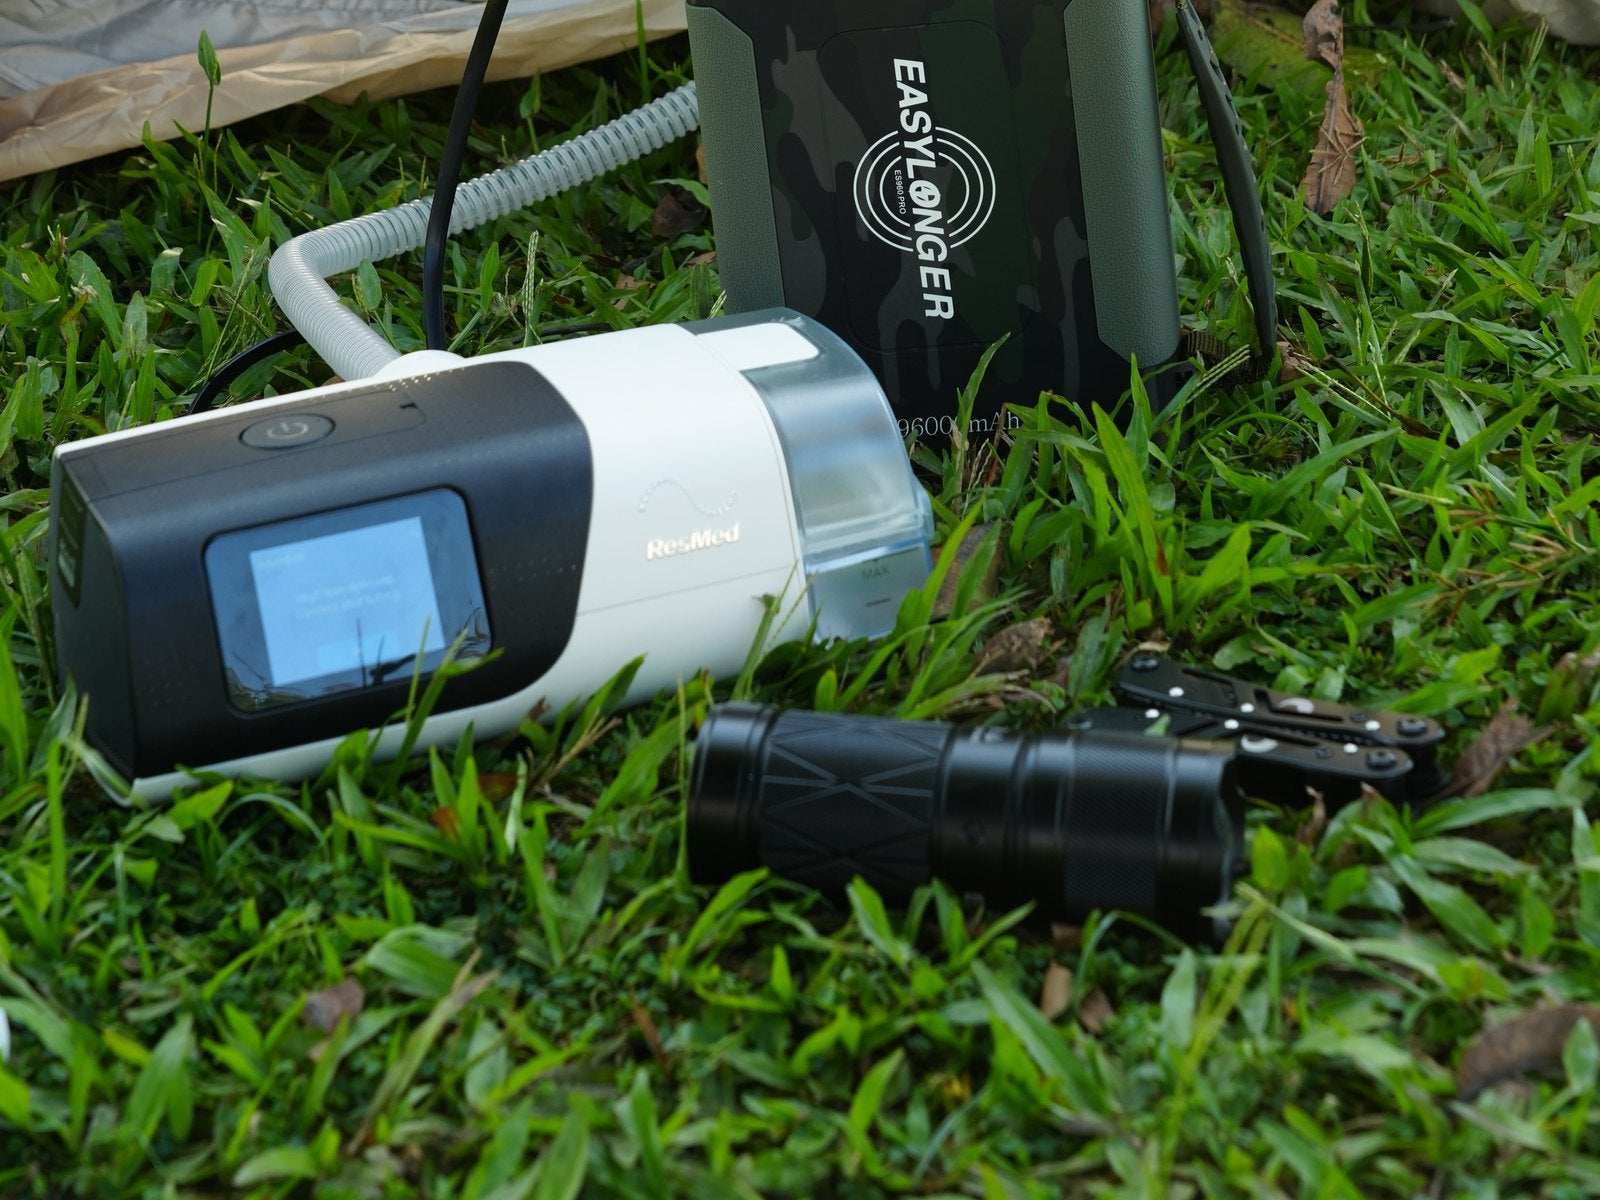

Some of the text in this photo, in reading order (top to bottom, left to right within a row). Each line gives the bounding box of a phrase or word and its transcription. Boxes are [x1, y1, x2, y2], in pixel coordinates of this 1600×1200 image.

[893, 58, 955, 320] EASYLONGER
[897, 196, 907, 215] PRO
[646, 520, 740, 561] ResMed
